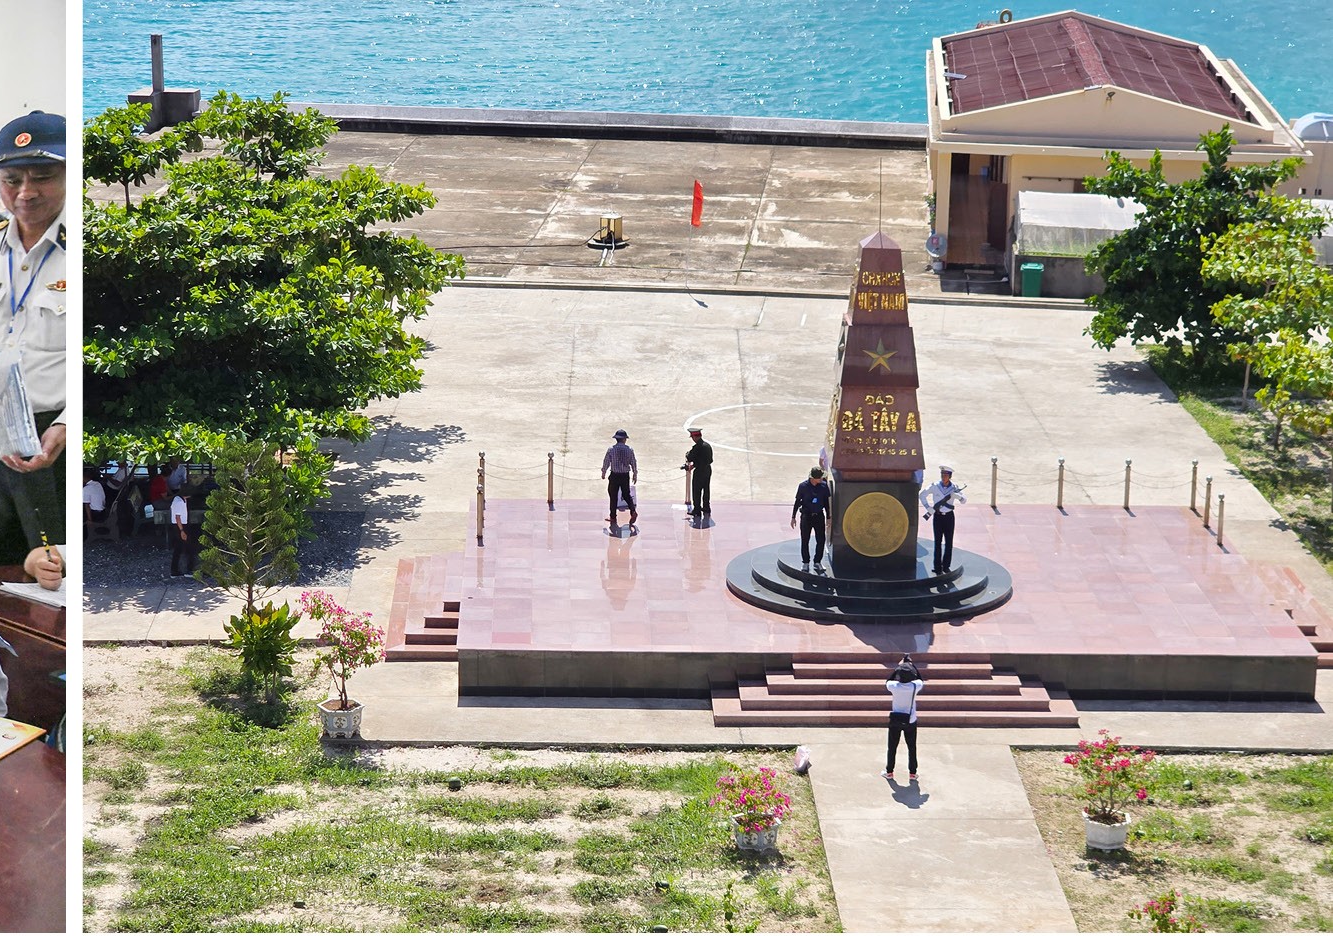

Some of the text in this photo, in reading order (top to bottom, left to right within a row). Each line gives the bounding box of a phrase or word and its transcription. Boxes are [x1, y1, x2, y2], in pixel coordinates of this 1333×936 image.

[858, 290, 905, 312] VIỆT NAM
[842, 407, 917, 432] ĐÁ TÂY A
